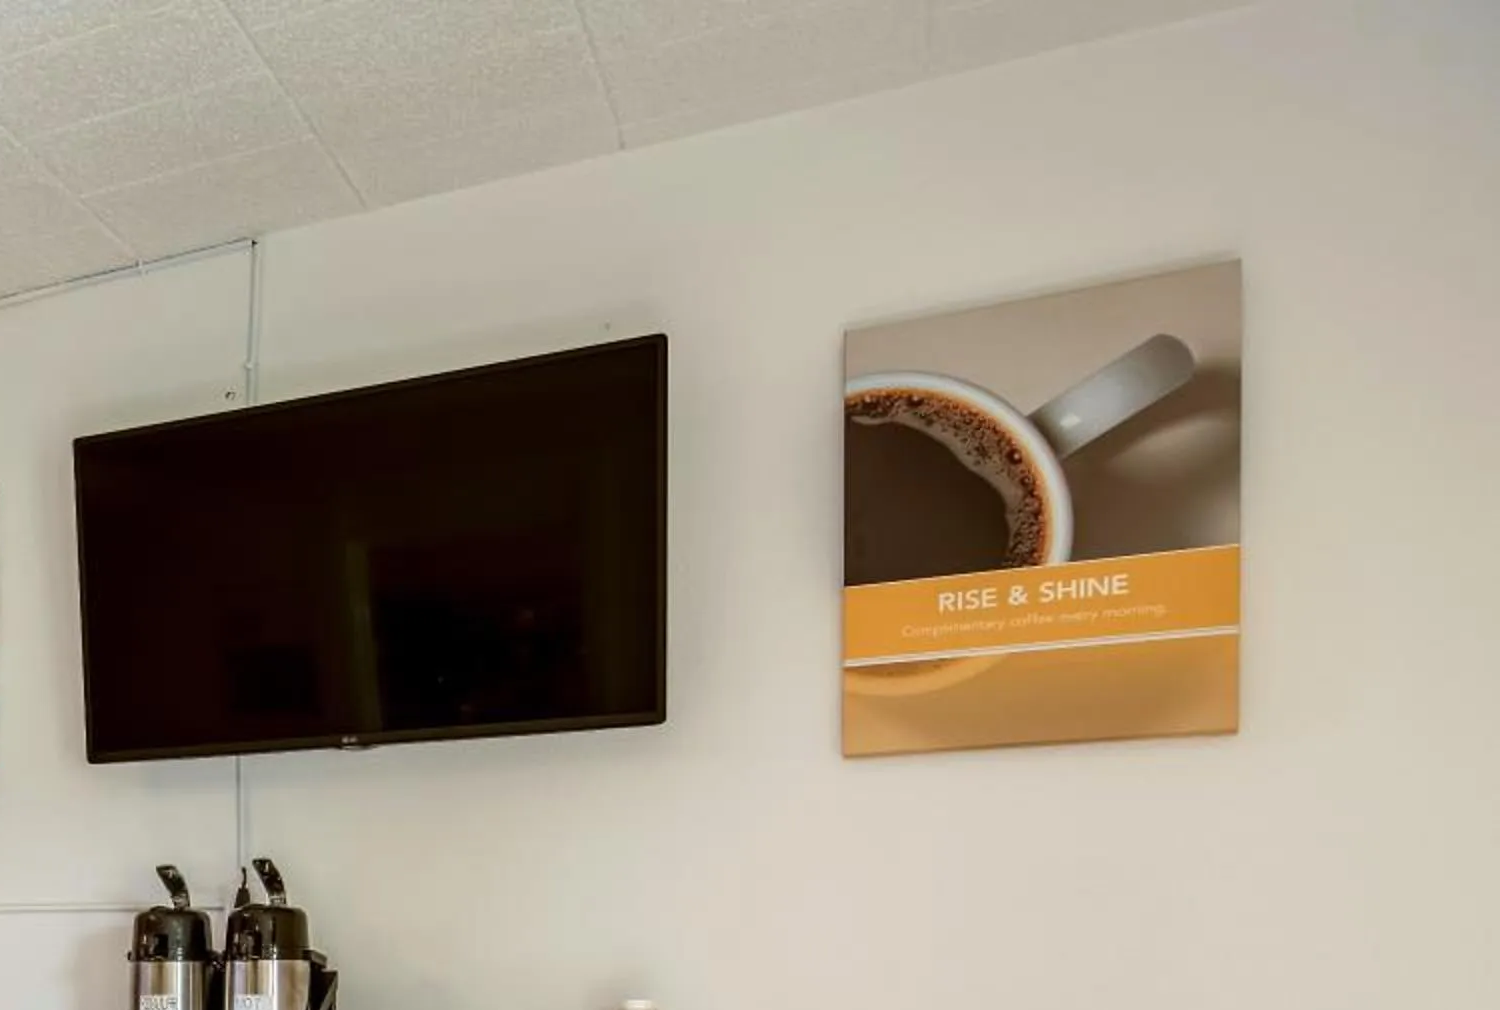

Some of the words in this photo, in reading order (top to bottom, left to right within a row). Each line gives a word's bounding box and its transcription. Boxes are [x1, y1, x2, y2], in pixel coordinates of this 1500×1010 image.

[937, 587, 997, 614] RISE
[1007, 584, 1029, 606] &
[1039, 573, 1130, 603] SHINE
[1009, 612, 1053, 628] coffee
